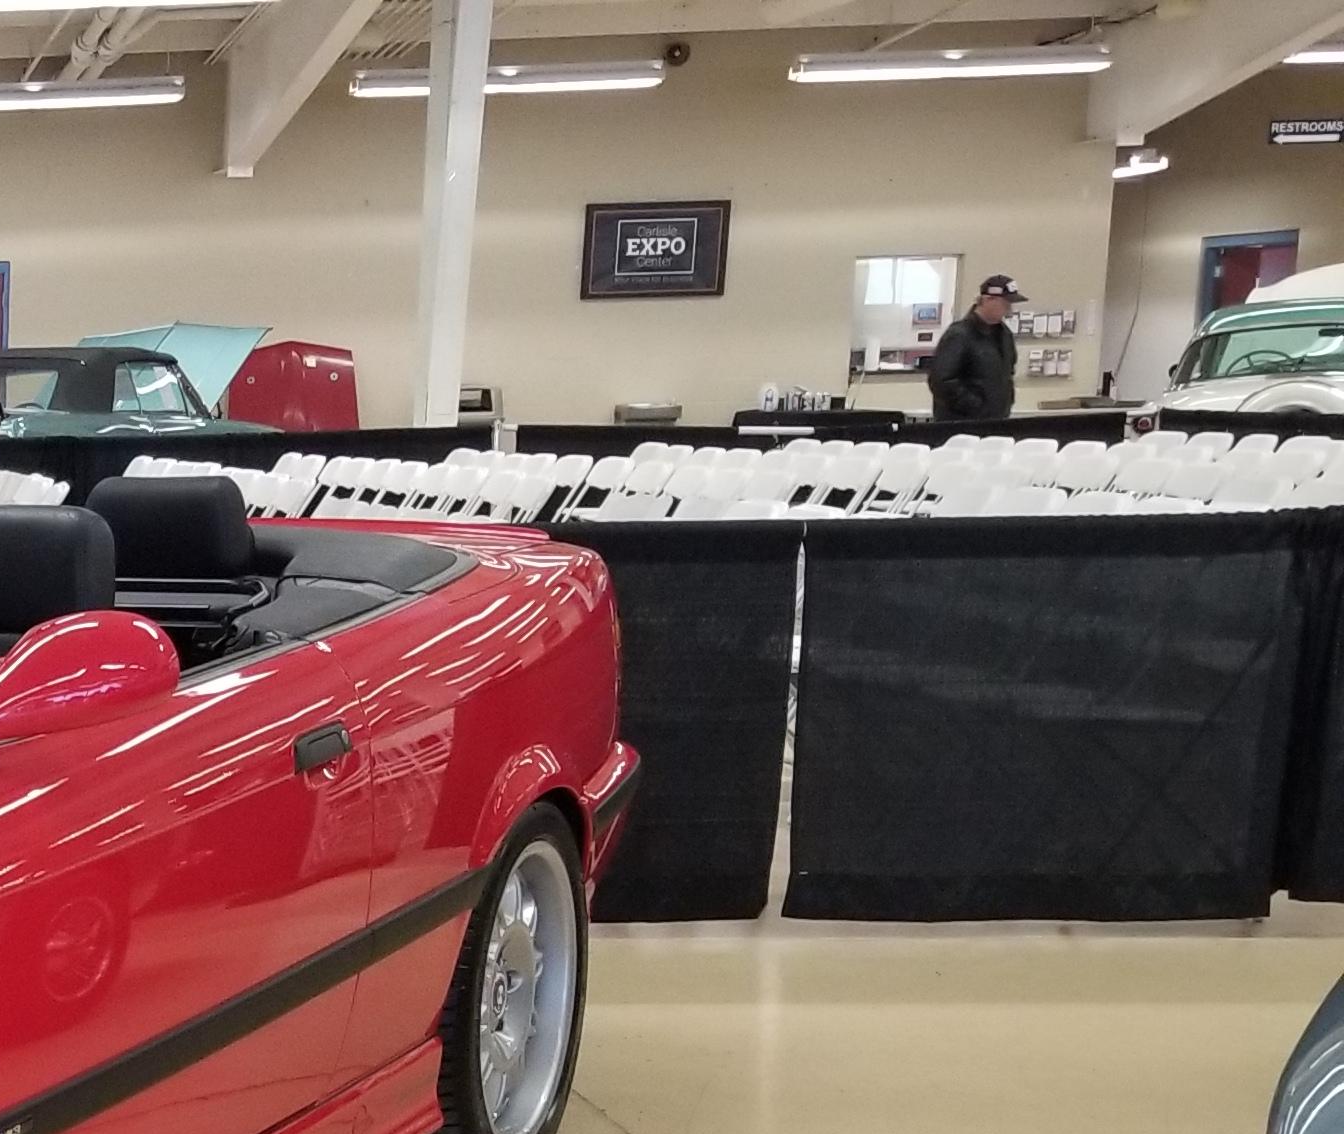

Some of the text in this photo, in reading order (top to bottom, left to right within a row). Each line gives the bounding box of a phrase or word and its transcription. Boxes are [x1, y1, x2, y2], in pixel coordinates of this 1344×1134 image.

[1272, 121, 1344, 133] RESTROOMS
[637, 224, 678, 237] Carlisle
[625, 236, 686, 256] EXPO
[635, 255, 673, 267] Center
